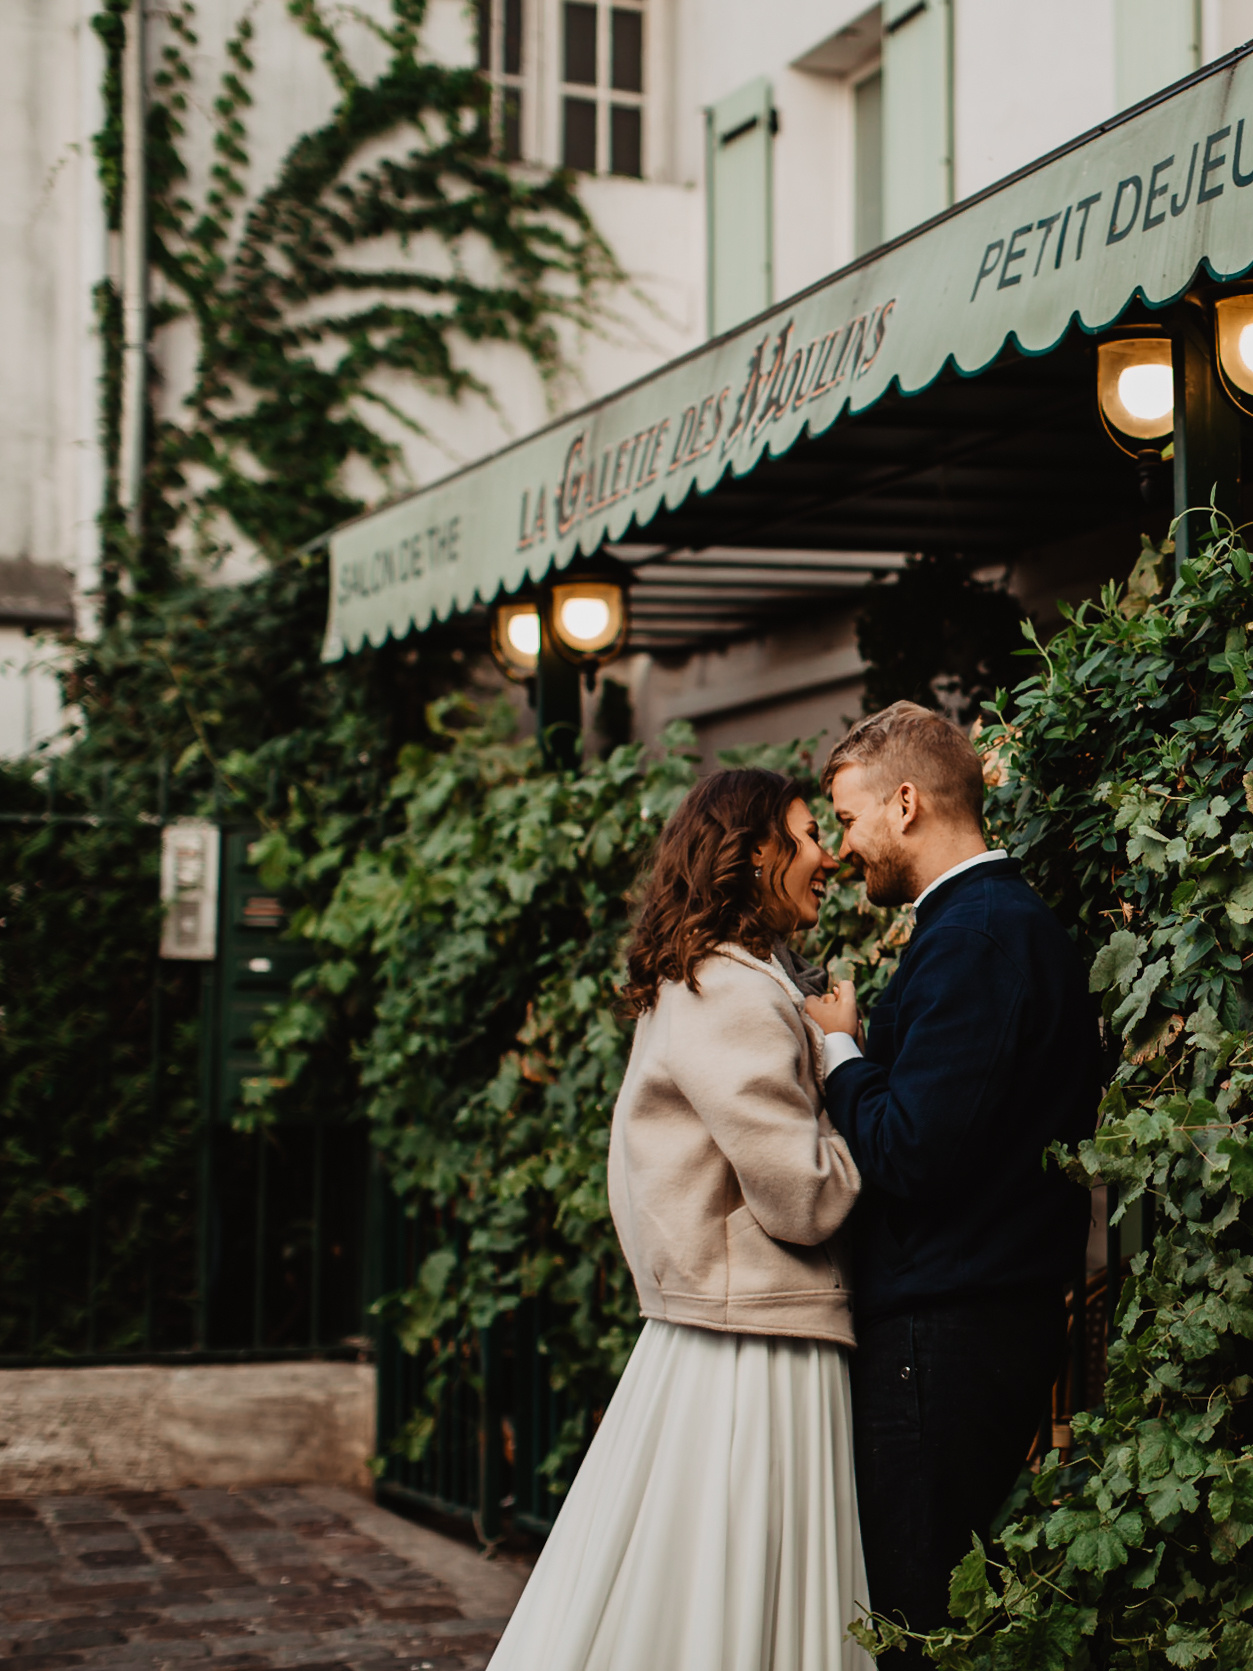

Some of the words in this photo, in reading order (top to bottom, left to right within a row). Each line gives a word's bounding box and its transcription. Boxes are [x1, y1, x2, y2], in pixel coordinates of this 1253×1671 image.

[970, 191, 1101, 302] PETIT
[517, 483, 548, 552] LA
[667, 386, 731, 477] DES
[720, 297, 896, 460] MOULINS
